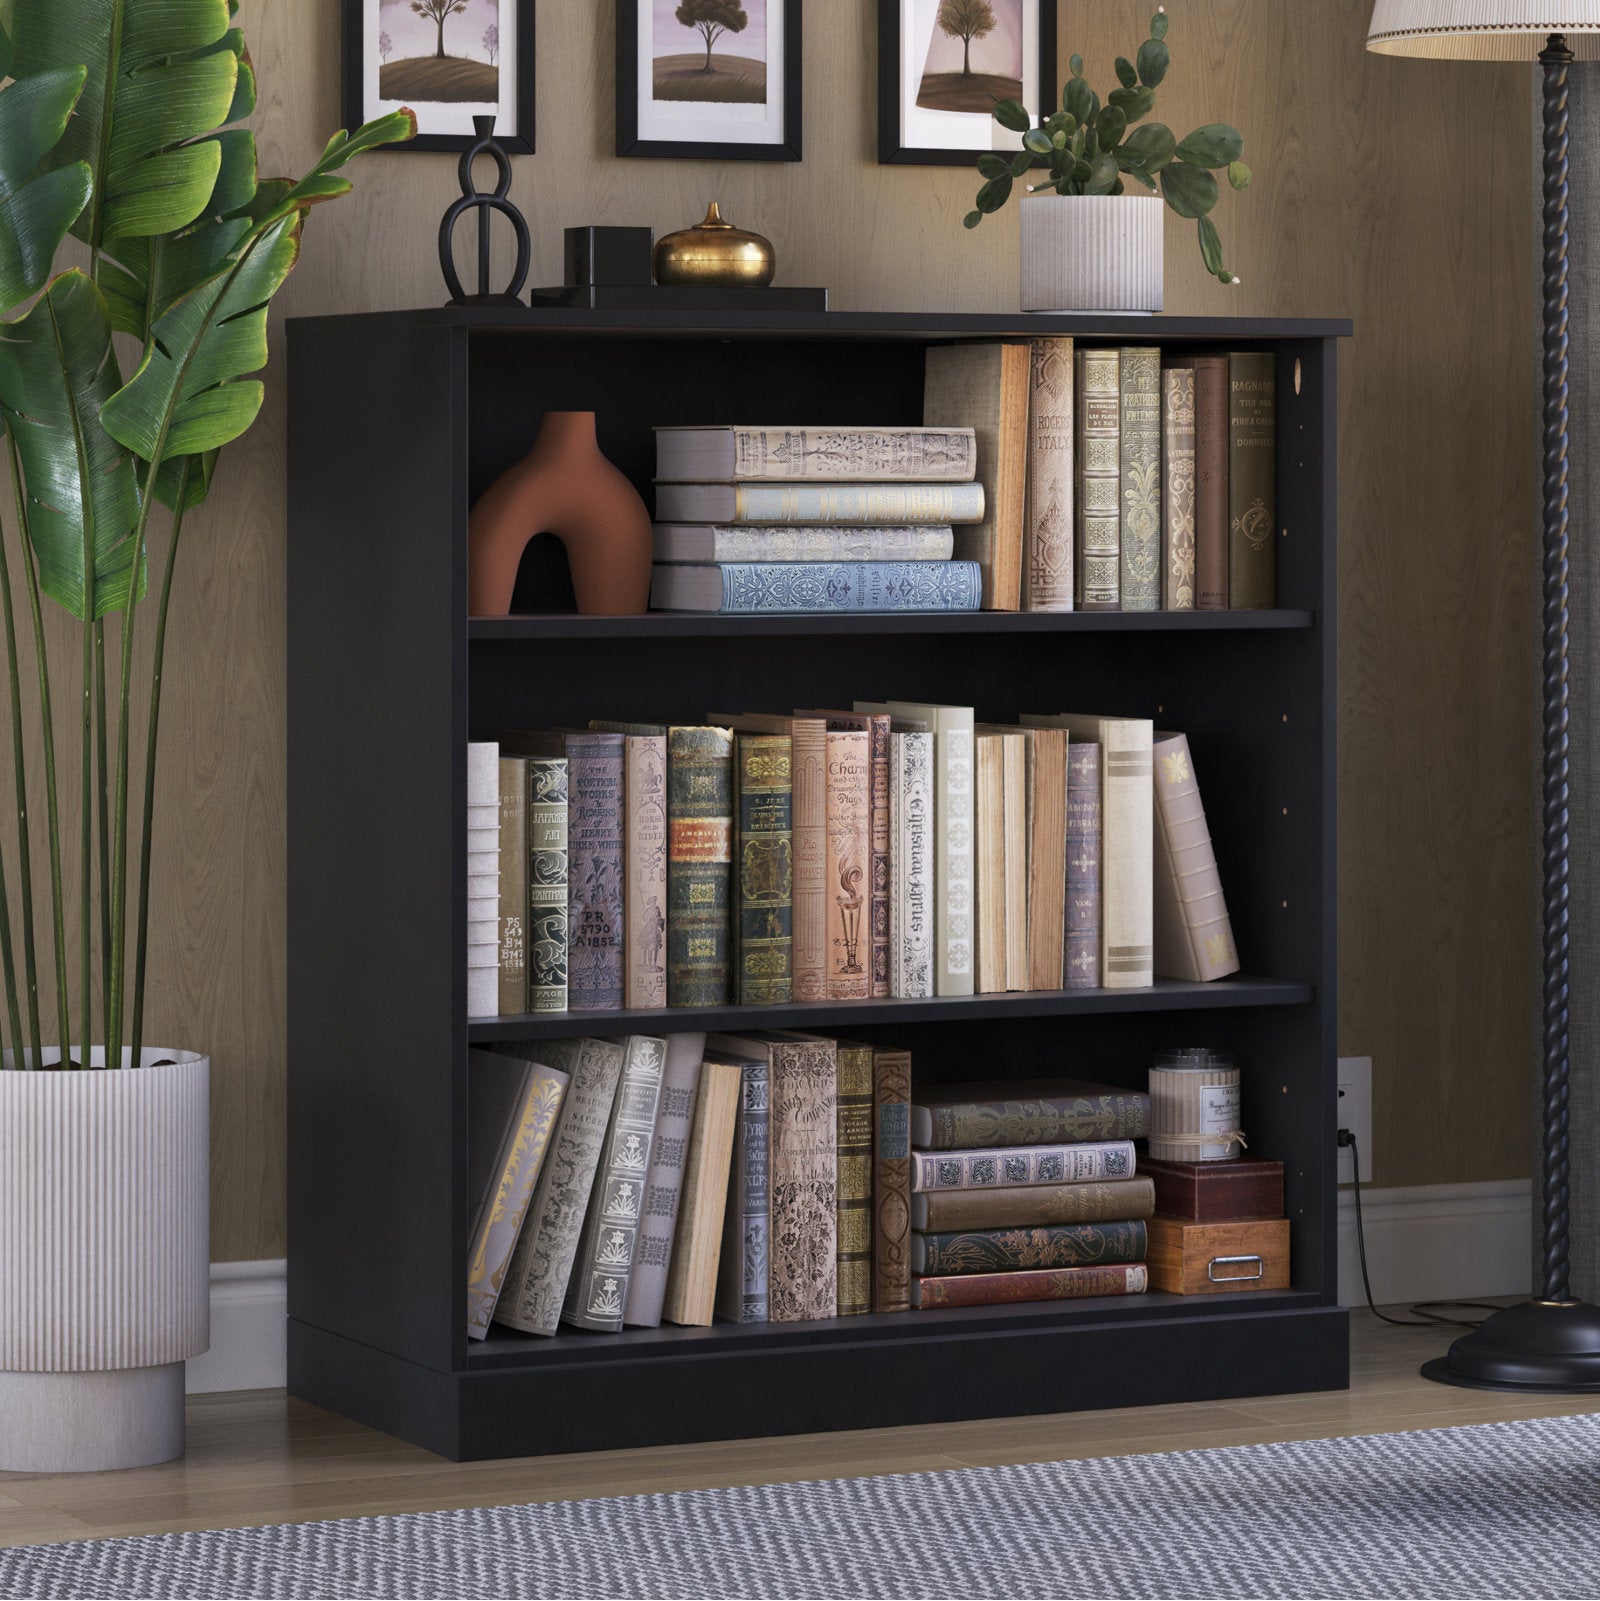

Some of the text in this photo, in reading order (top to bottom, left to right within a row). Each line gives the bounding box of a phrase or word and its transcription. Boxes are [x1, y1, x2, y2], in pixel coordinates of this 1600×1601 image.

[1038, 436, 1070, 450] ITALY
[843, 751, 857, 760] The
[829, 762, 867, 775] Charm
[578, 790, 614, 799] WORKS
[544, 830, 560, 840] ART
[581, 828, 612, 837] HENRY
[582, 912, 604, 922] PR
[507, 917, 520, 928] PS
[581, 924, 610, 934] 5790
